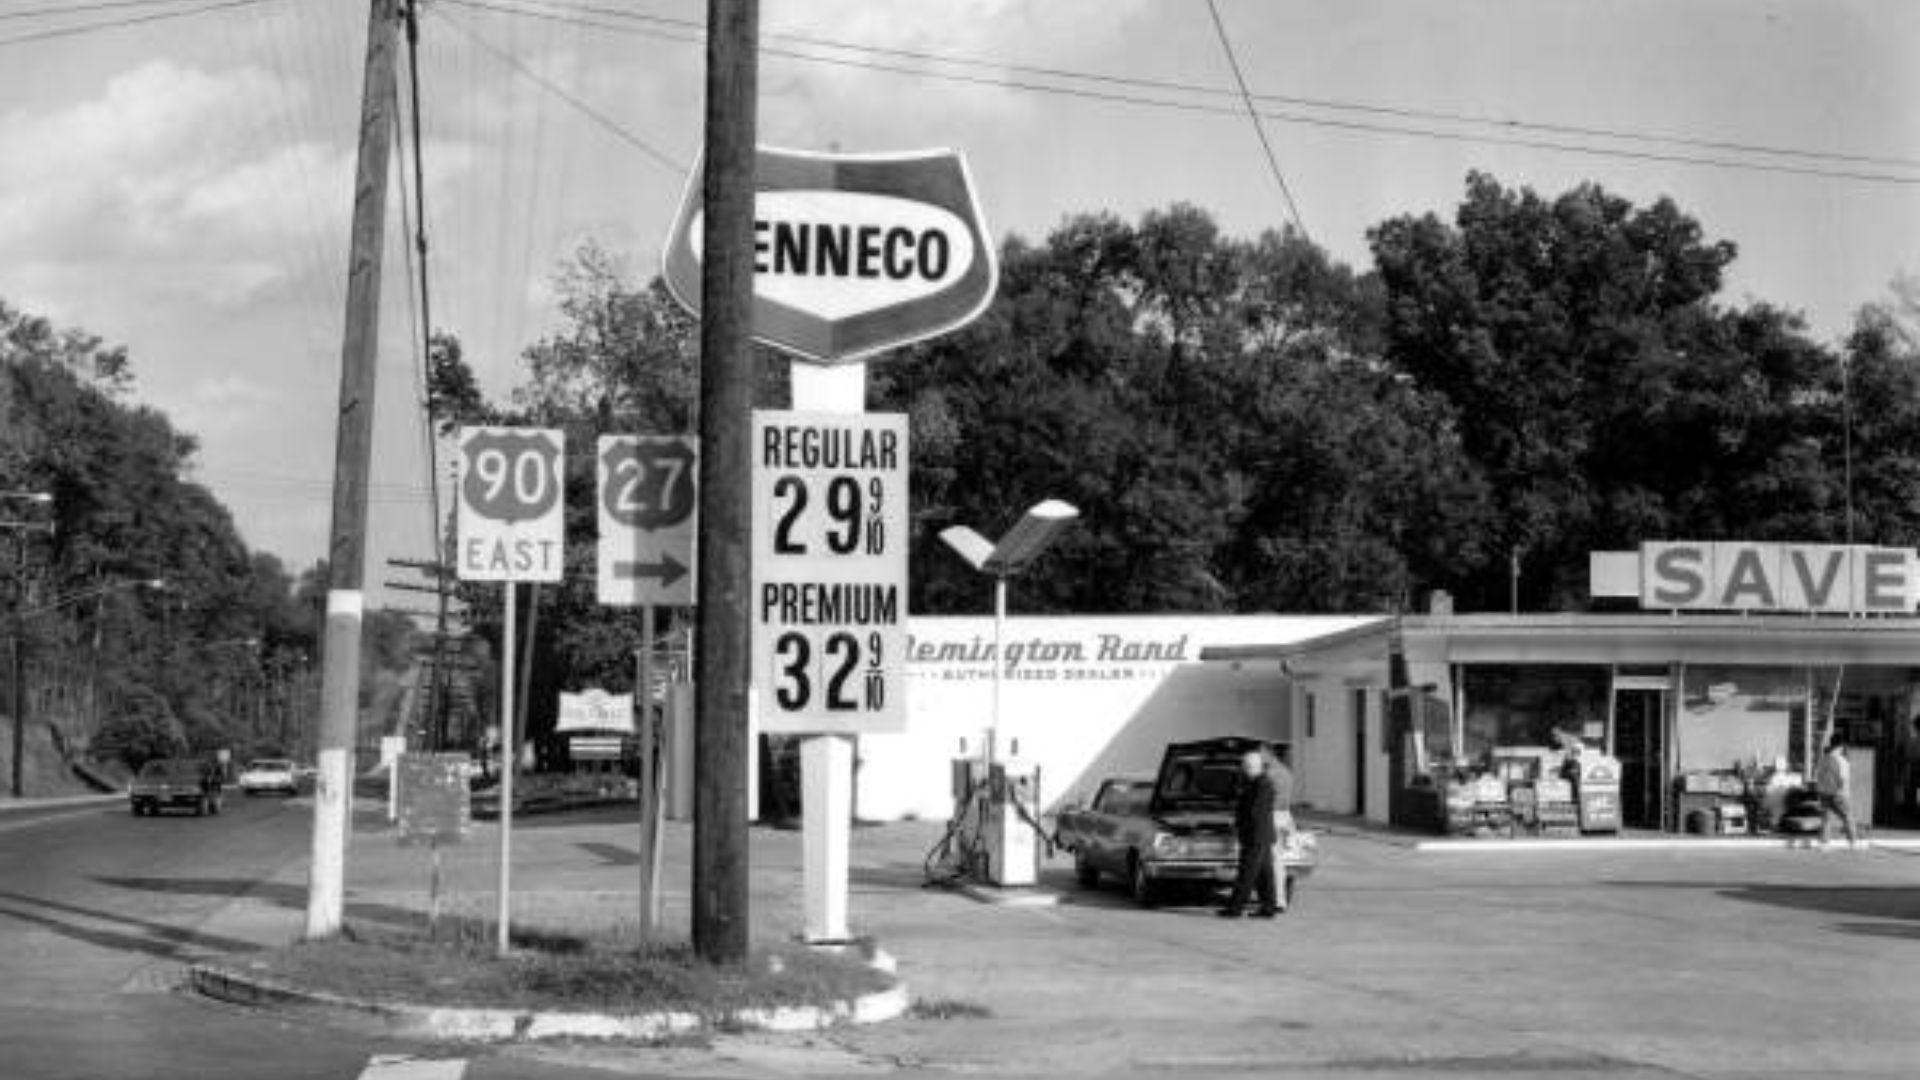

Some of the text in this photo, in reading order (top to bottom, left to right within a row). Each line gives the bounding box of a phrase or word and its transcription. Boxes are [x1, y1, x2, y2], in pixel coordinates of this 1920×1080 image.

[754, 221, 949, 281] ENNECO
[763, 426, 897, 468] REGULAR
[476, 450, 546, 504] 90
[617, 458, 684, 511] 27
[774, 475, 862, 555] 29
[467, 537, 554, 571] EAST
[1654, 547, 1905, 607] SAVE
[761, 583, 897, 625] PREMIUM
[775, 632, 861, 711] 32
[1097, 634, 1188, 661] Rand
